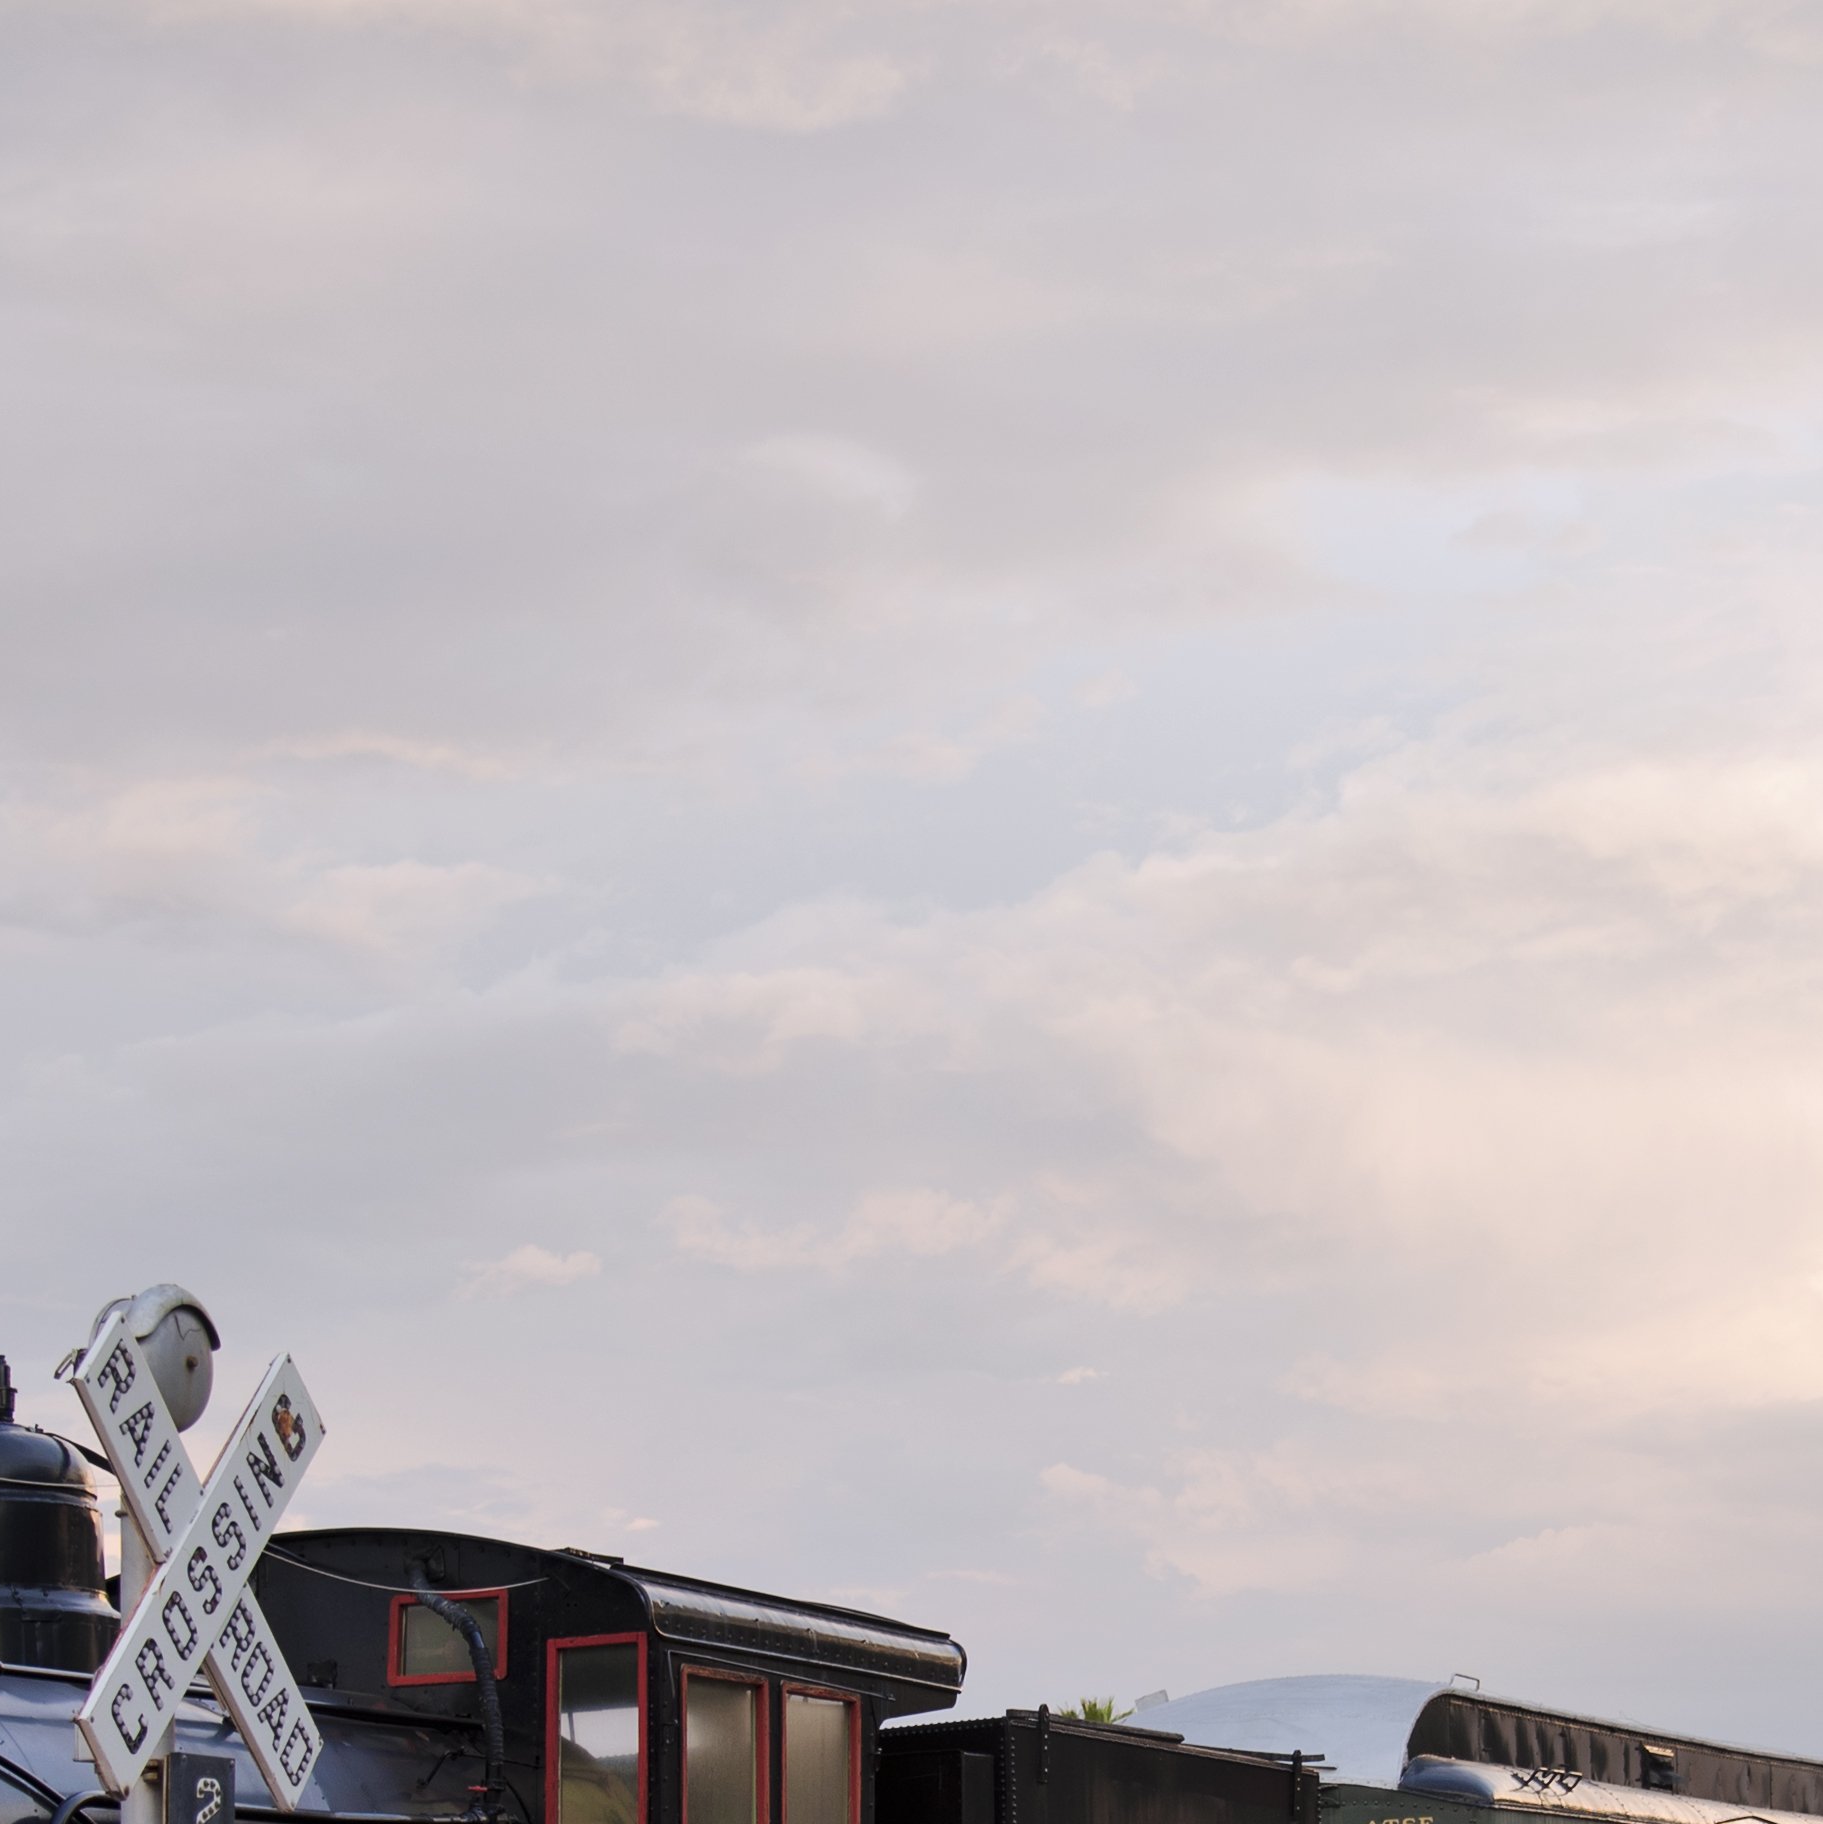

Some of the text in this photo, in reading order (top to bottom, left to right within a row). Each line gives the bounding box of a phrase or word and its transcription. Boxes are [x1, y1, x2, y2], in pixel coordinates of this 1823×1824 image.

[97, 1338, 182, 1535] RAIL
[111, 1394, 305, 1755] CROSSING
[219, 1597, 313, 1786] ROAD
